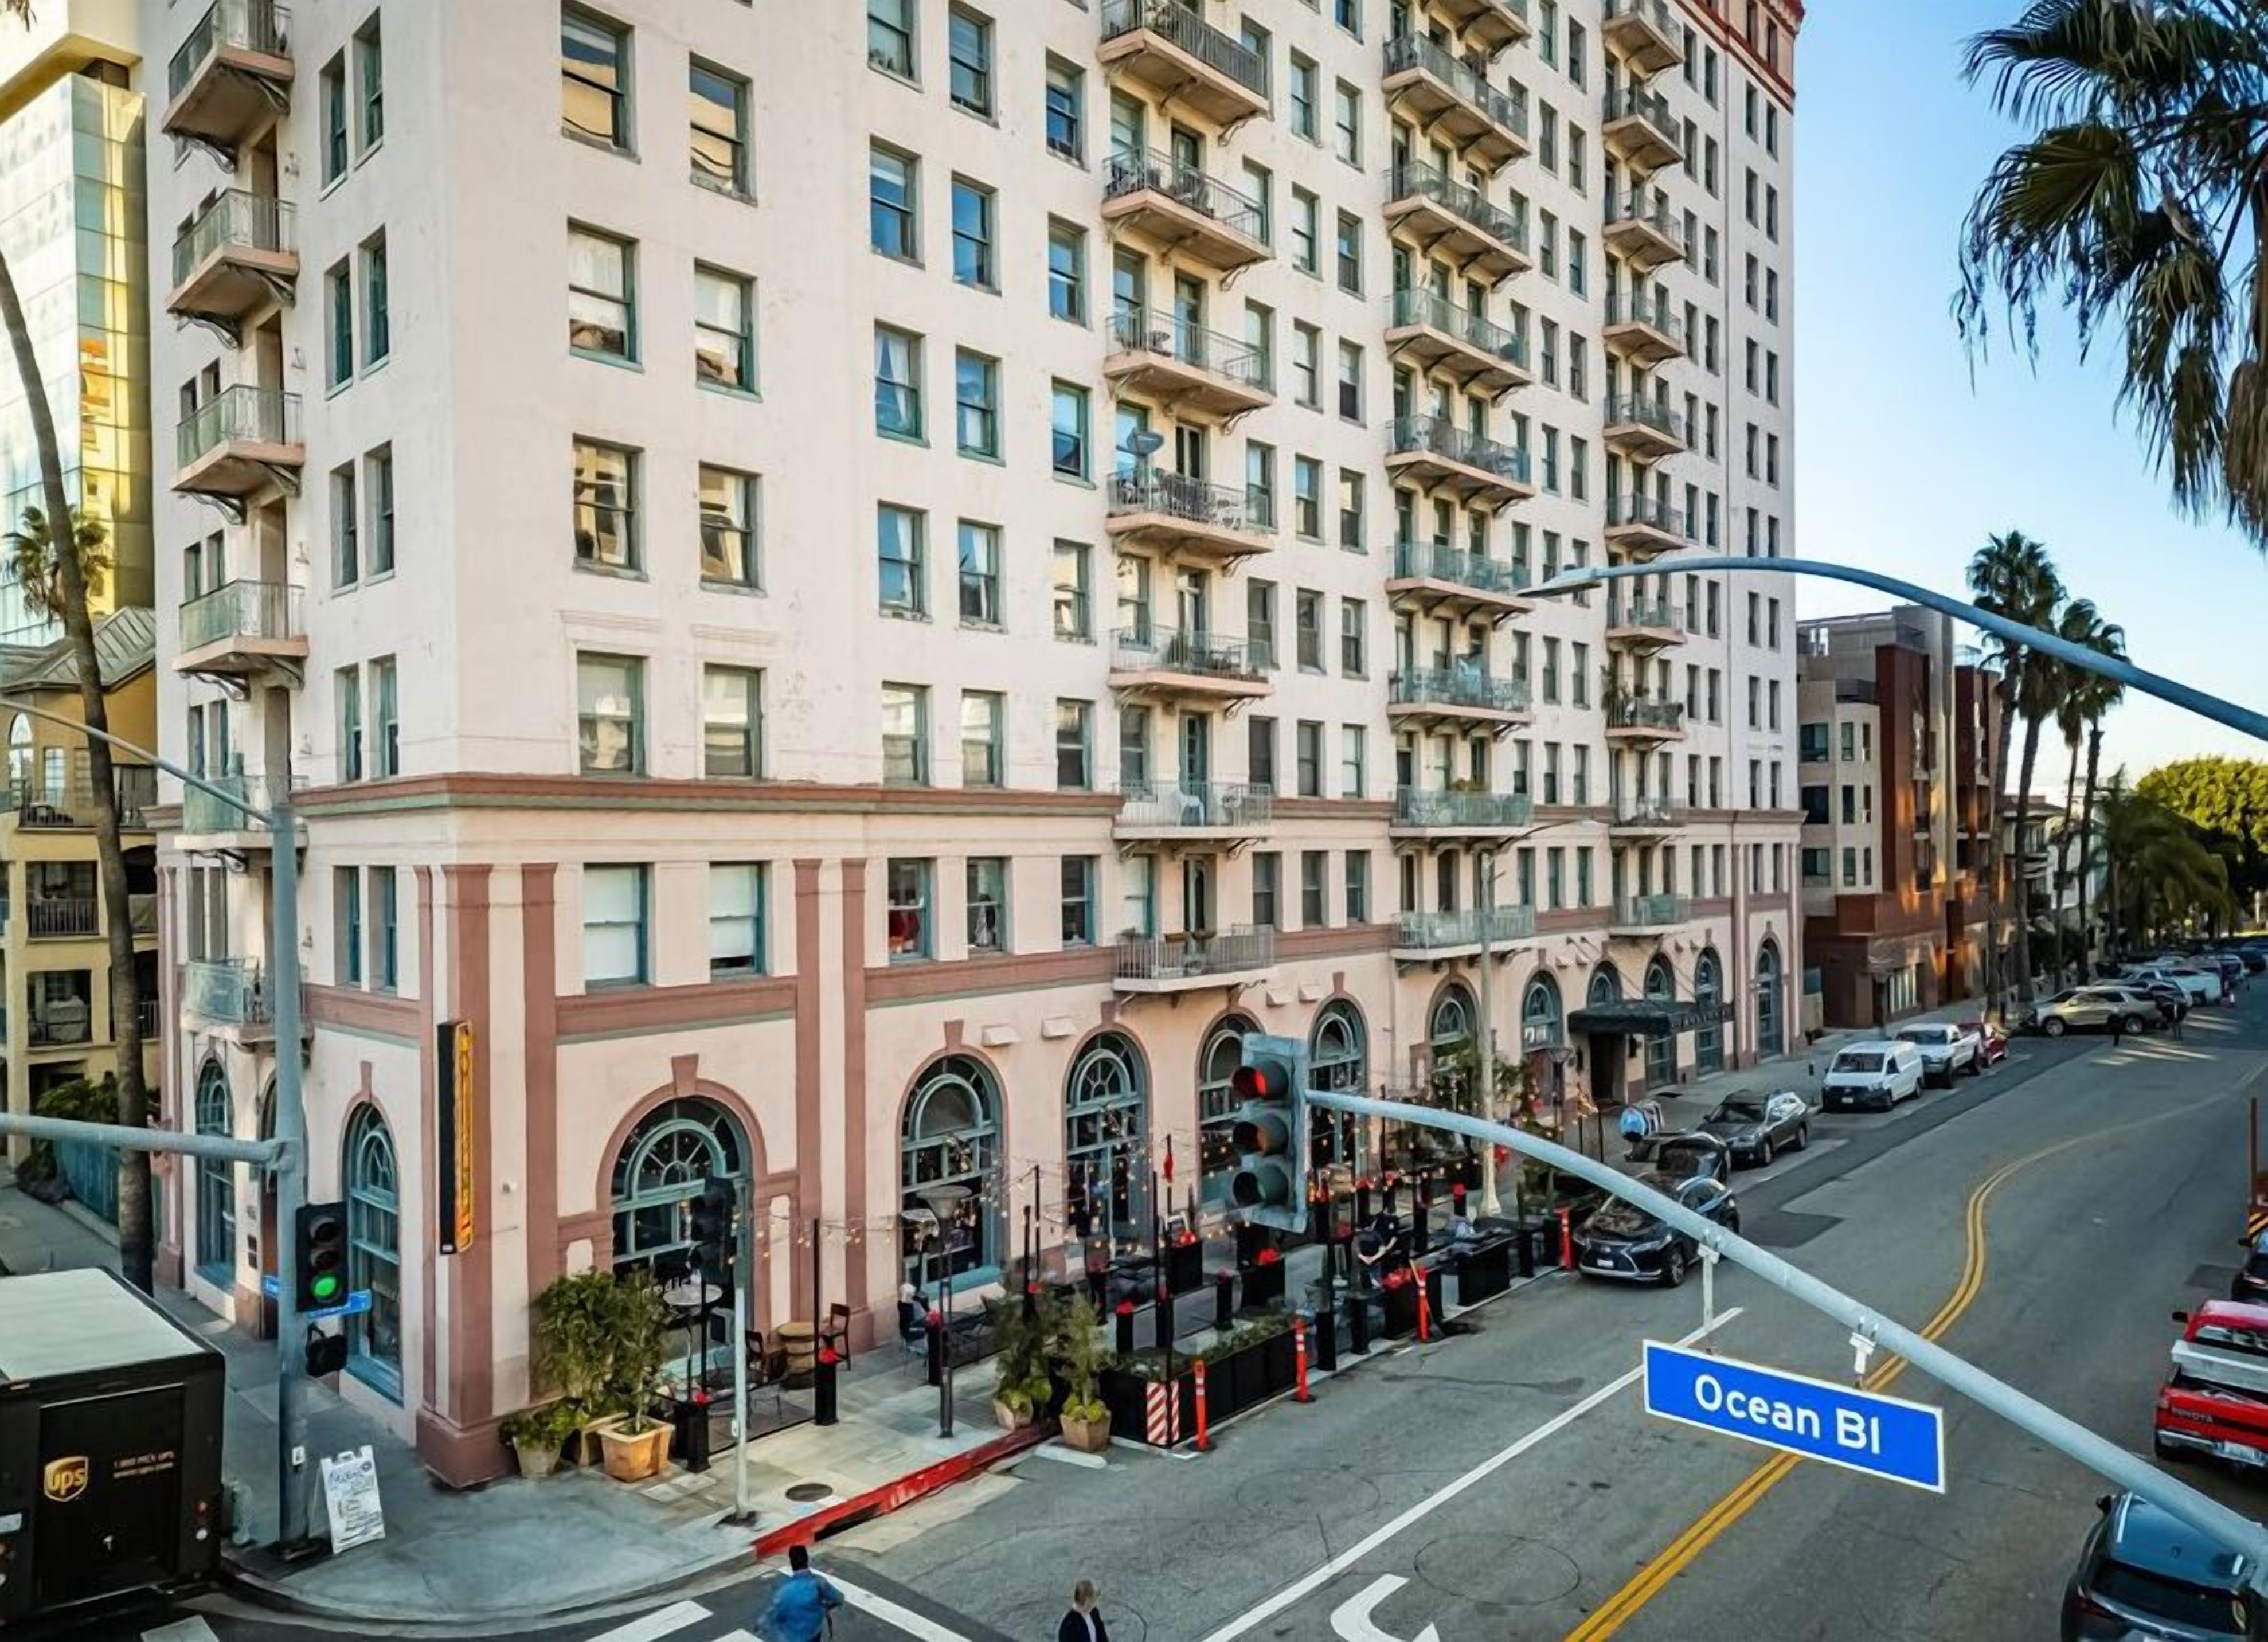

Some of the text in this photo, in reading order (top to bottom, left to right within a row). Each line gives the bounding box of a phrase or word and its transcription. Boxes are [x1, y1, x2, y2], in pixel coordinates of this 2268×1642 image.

[1695, 1374, 1880, 1454] Ocean Bl
[48, 1468, 86, 1496] ups
